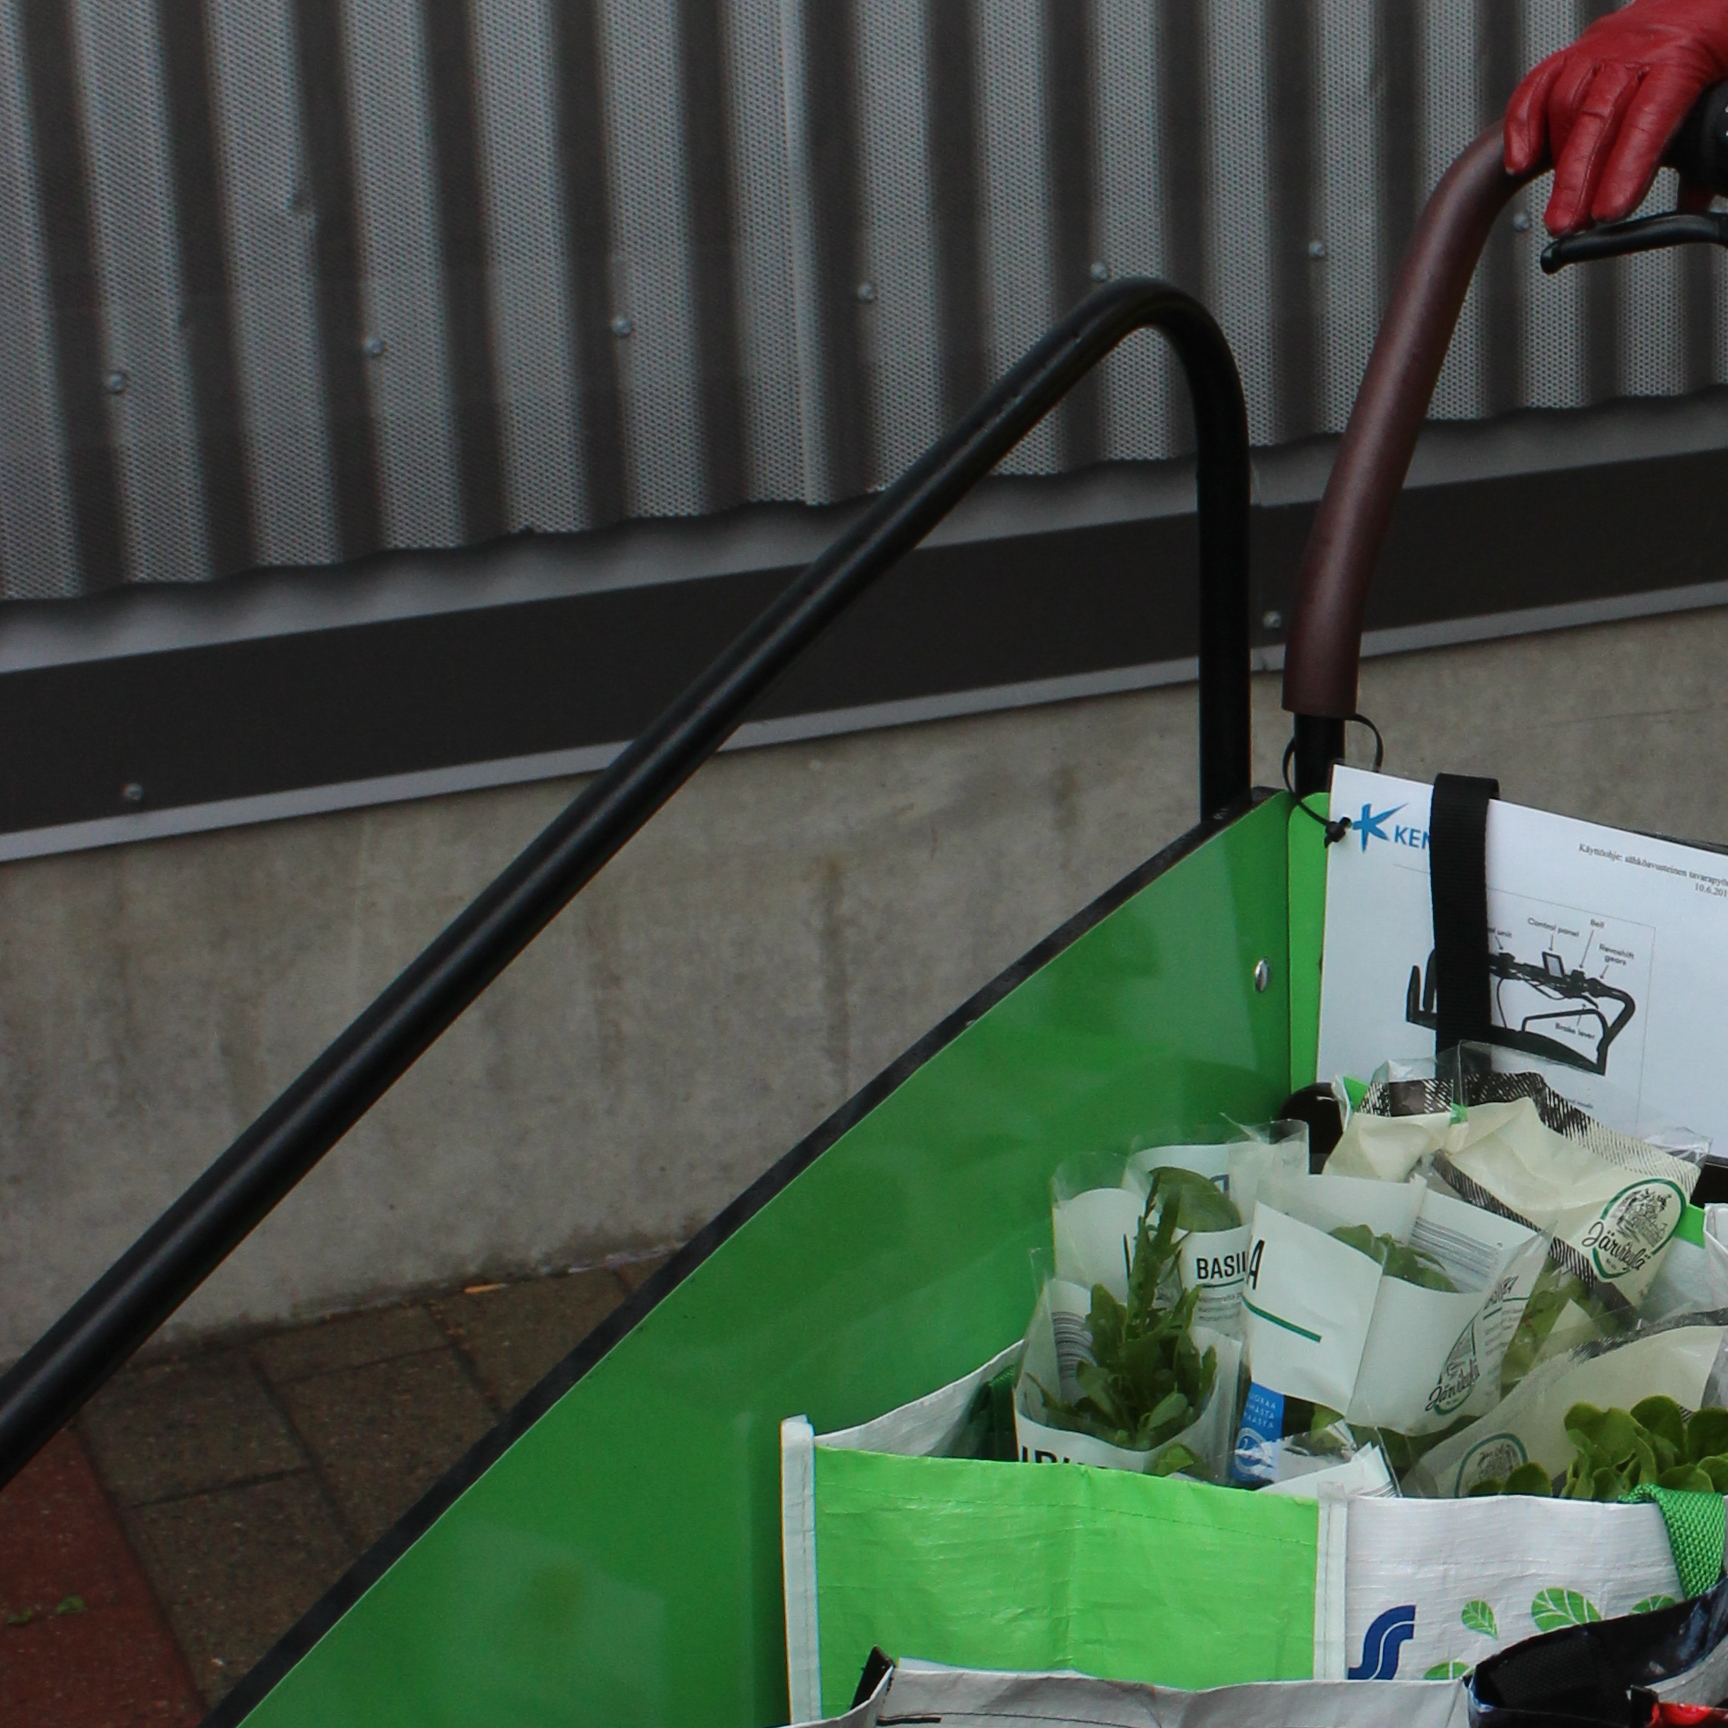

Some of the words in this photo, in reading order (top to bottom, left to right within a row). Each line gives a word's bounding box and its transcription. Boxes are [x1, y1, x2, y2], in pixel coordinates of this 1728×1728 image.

[1578, 842, 1623, 863] Käyttöohje:
[1527, 917, 1557, 932] Control
[1557, 926, 1580, 939] panel
[1580, 1220, 1652, 1272] Järvikylä
